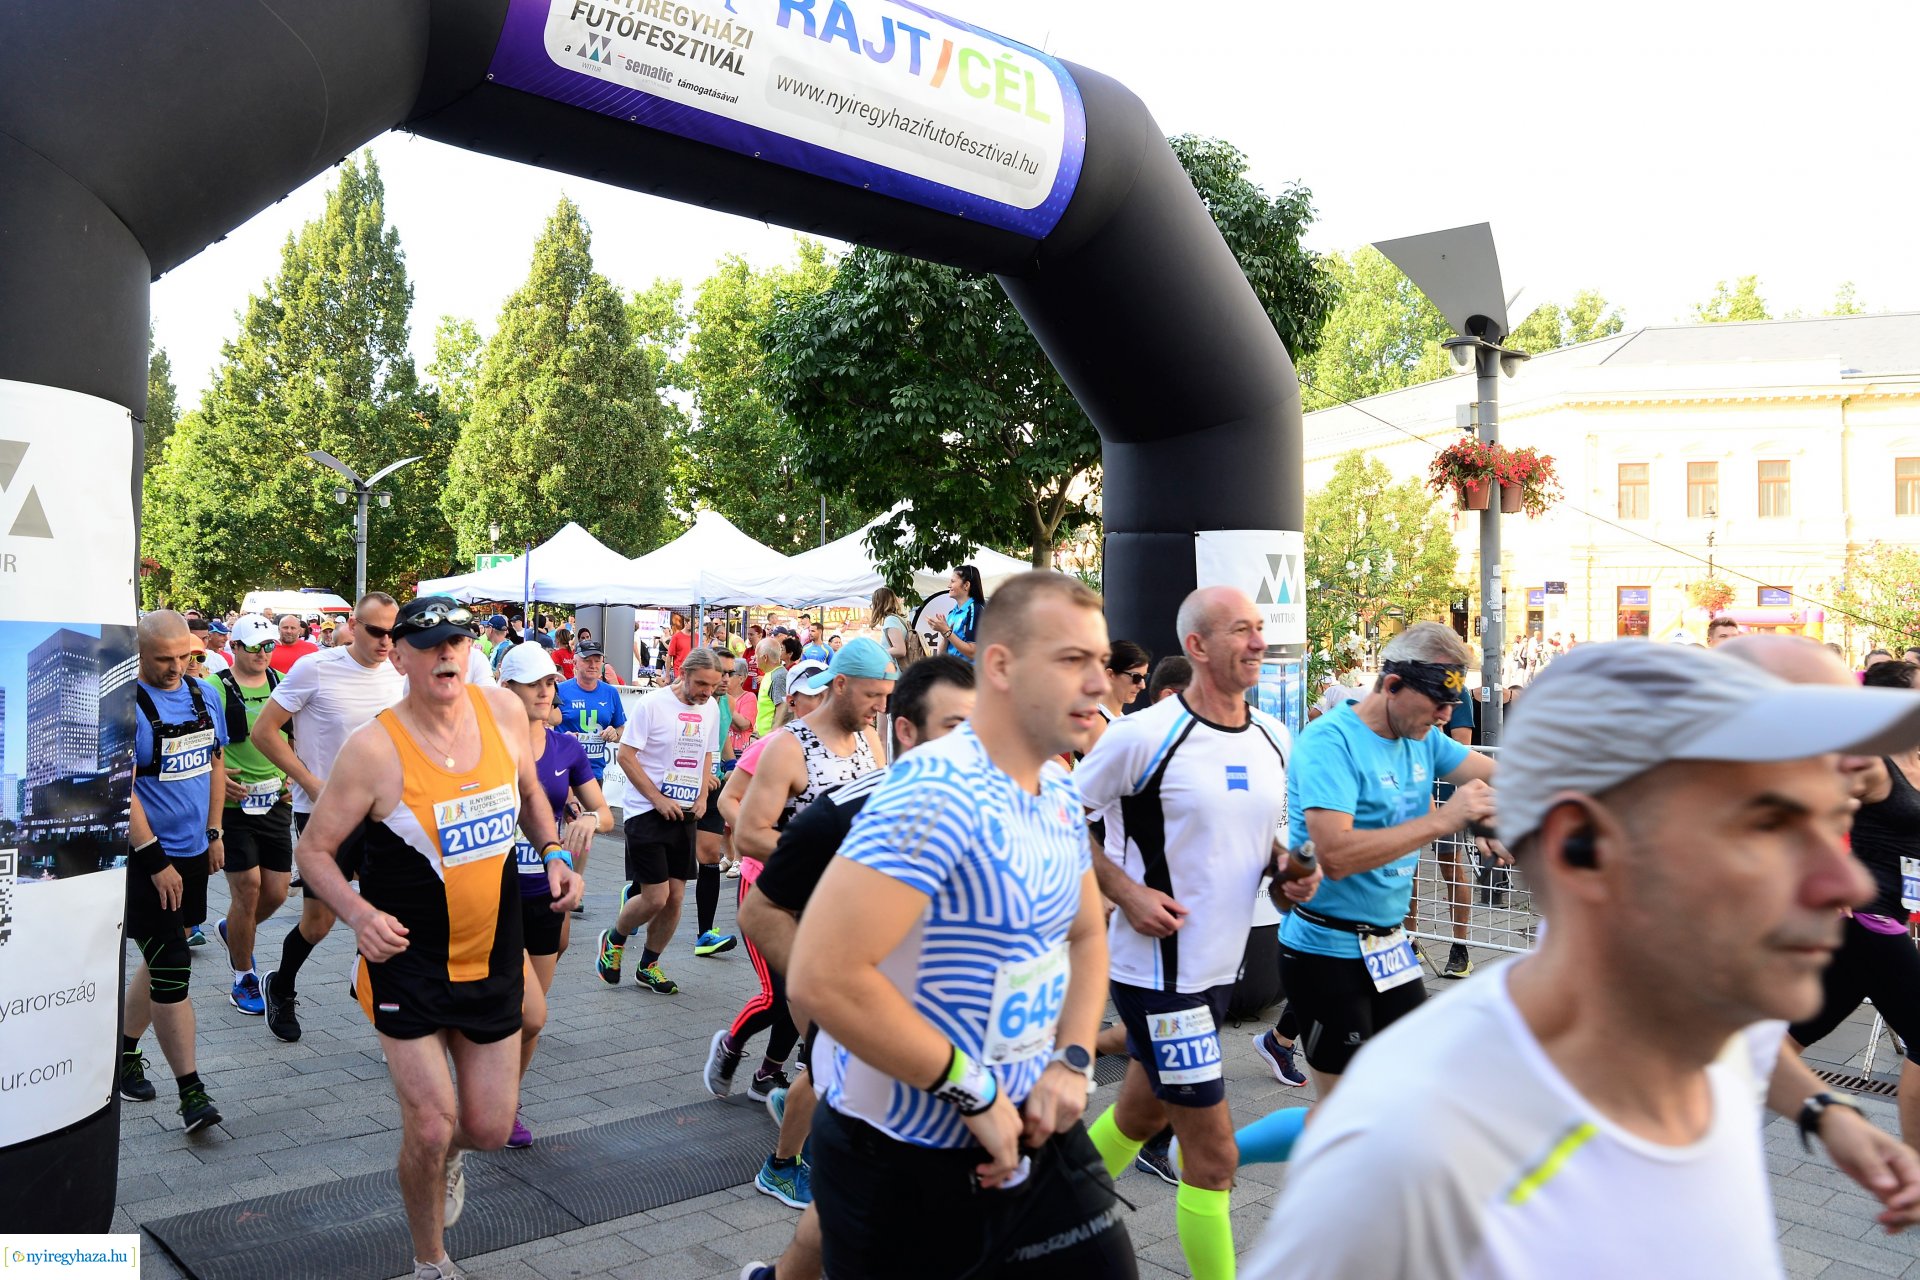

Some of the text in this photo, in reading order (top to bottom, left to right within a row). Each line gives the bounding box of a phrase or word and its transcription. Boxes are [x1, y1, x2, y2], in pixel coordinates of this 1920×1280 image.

[570, 0, 745, 76] FUTÓFESZTIVÁL
[625, 57, 674, 84] sematic
[677, 78, 739, 104] támogatásával
[776, 73, 1039, 176] www.nyiregyhazifutofesztival.hu
[166, 749, 207, 772] 21061
[663, 785, 696, 799] 21004
[445, 813, 513, 853] 21020
[998, 973, 1065, 1039] 645
[1, 1058, 73, 1092] ur.com
